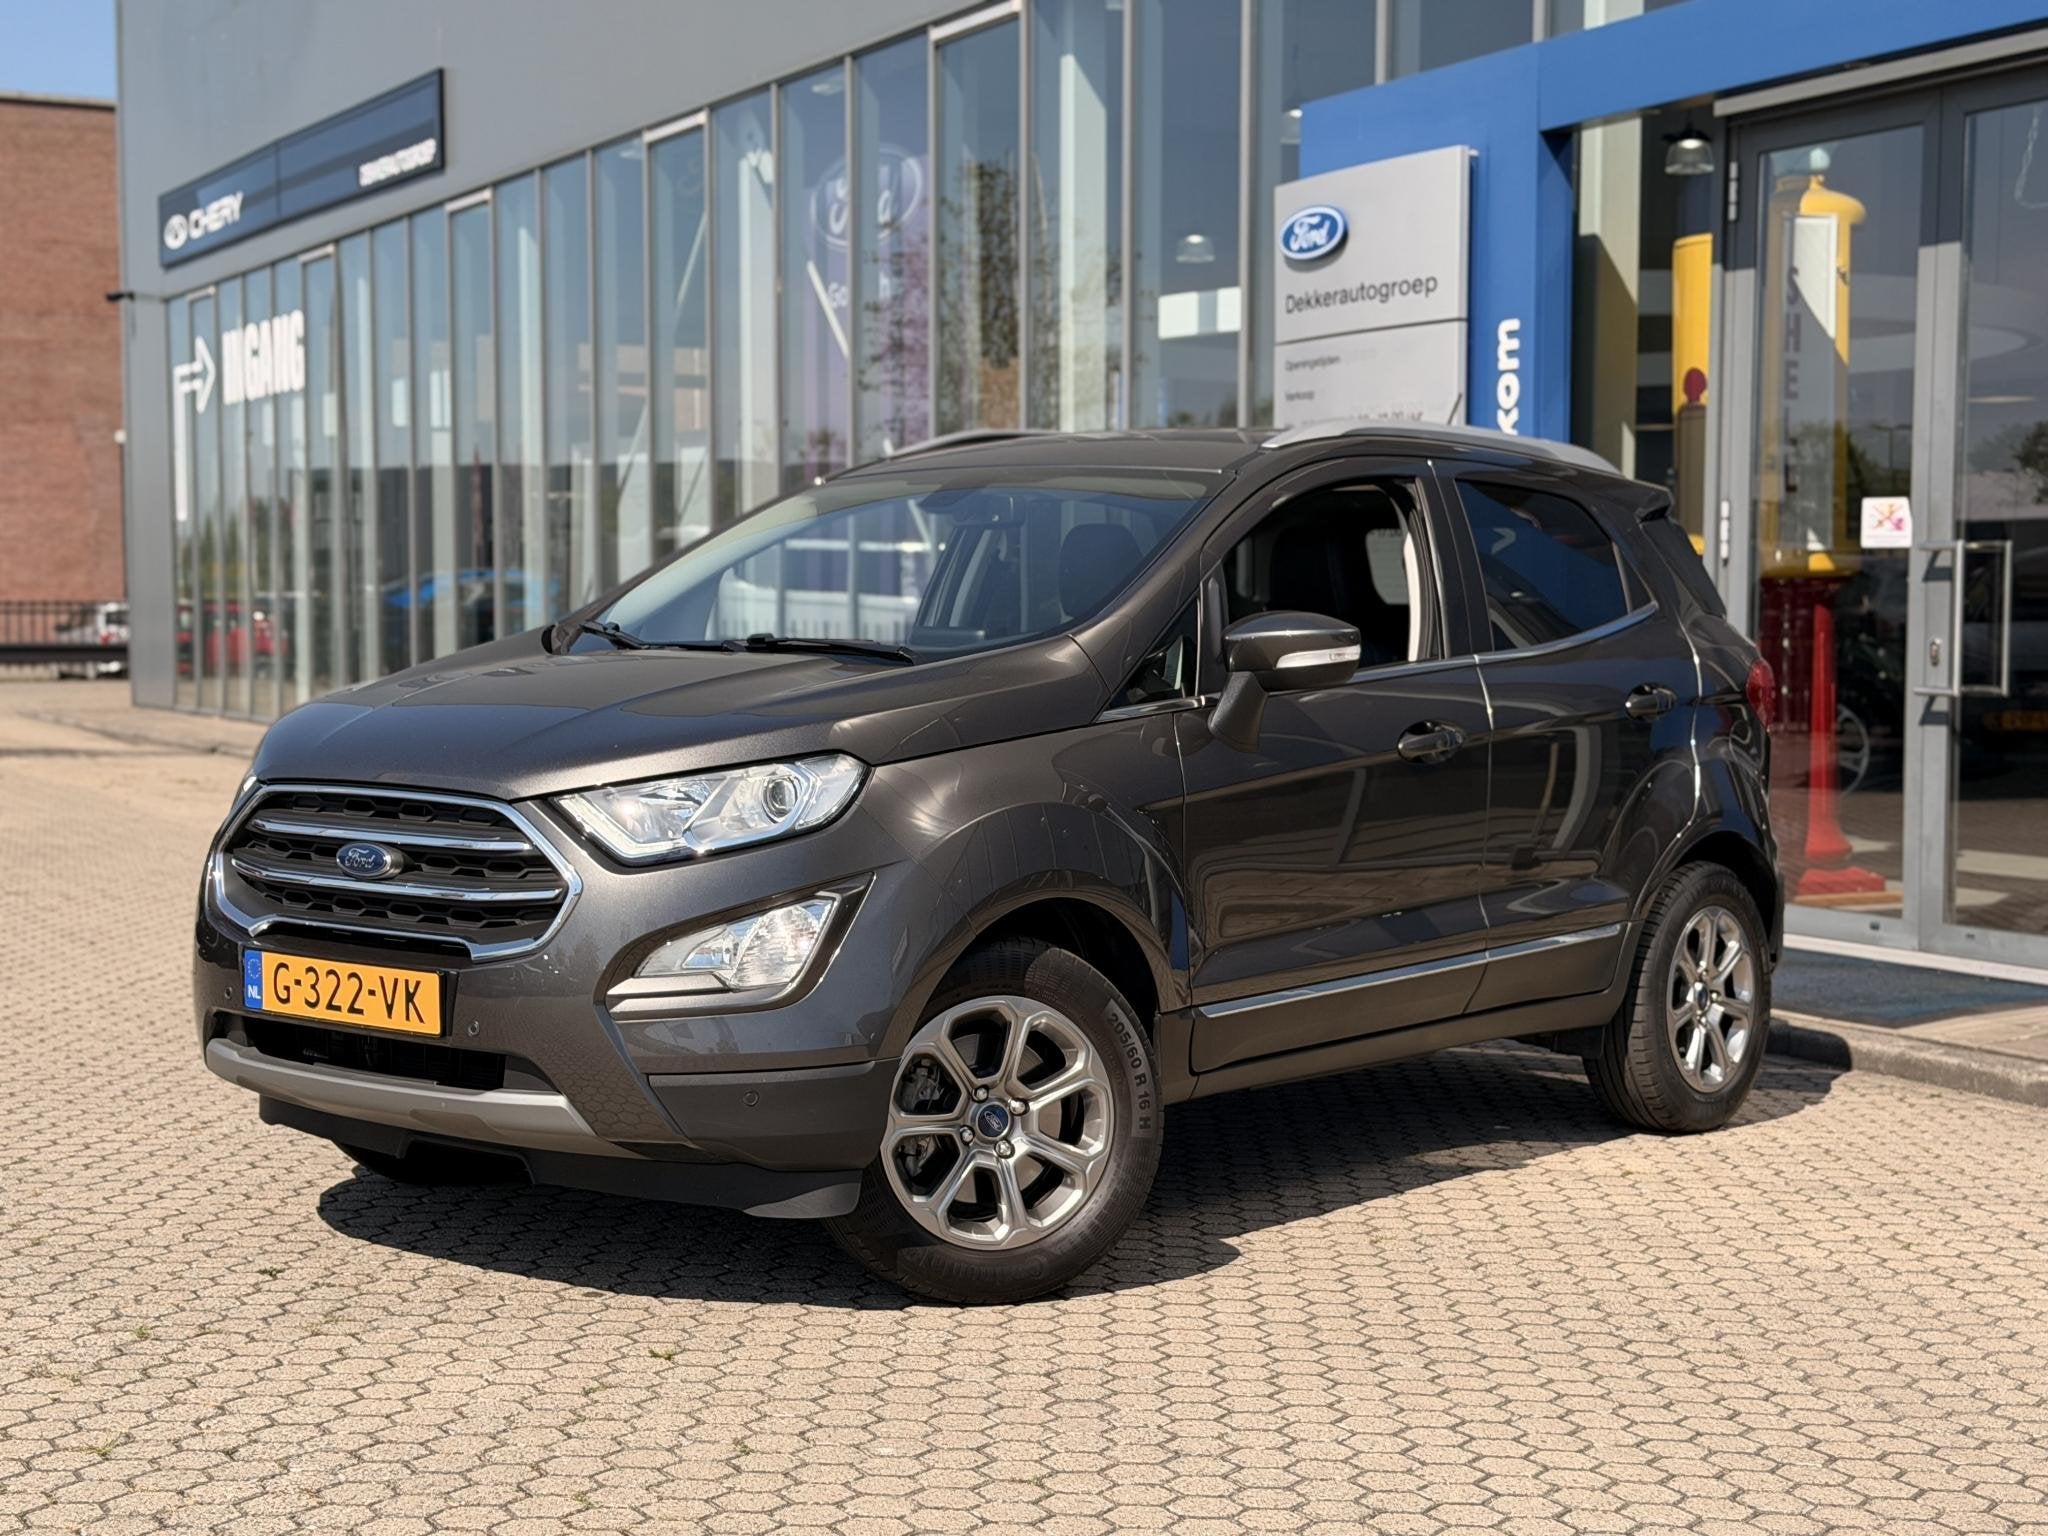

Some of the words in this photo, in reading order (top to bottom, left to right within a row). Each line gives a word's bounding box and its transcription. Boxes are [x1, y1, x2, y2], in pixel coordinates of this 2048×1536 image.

[187, 191, 244, 240] CHERY
[1290, 214, 1331, 251] Ford
[1285, 276, 1438, 315] Dekkerautogroep
[222, 309, 305, 404] INGANG
[344, 847, 376, 869] Ford
[247, 985, 261, 1000] NL
[273, 961, 425, 1025] G-322-VK
[1107, 1013, 1142, 1069] 205/60
[1134, 1072, 1147, 1087] R
[1137, 1091, 1150, 1110] 16
[1138, 1115, 1151, 1130] H
